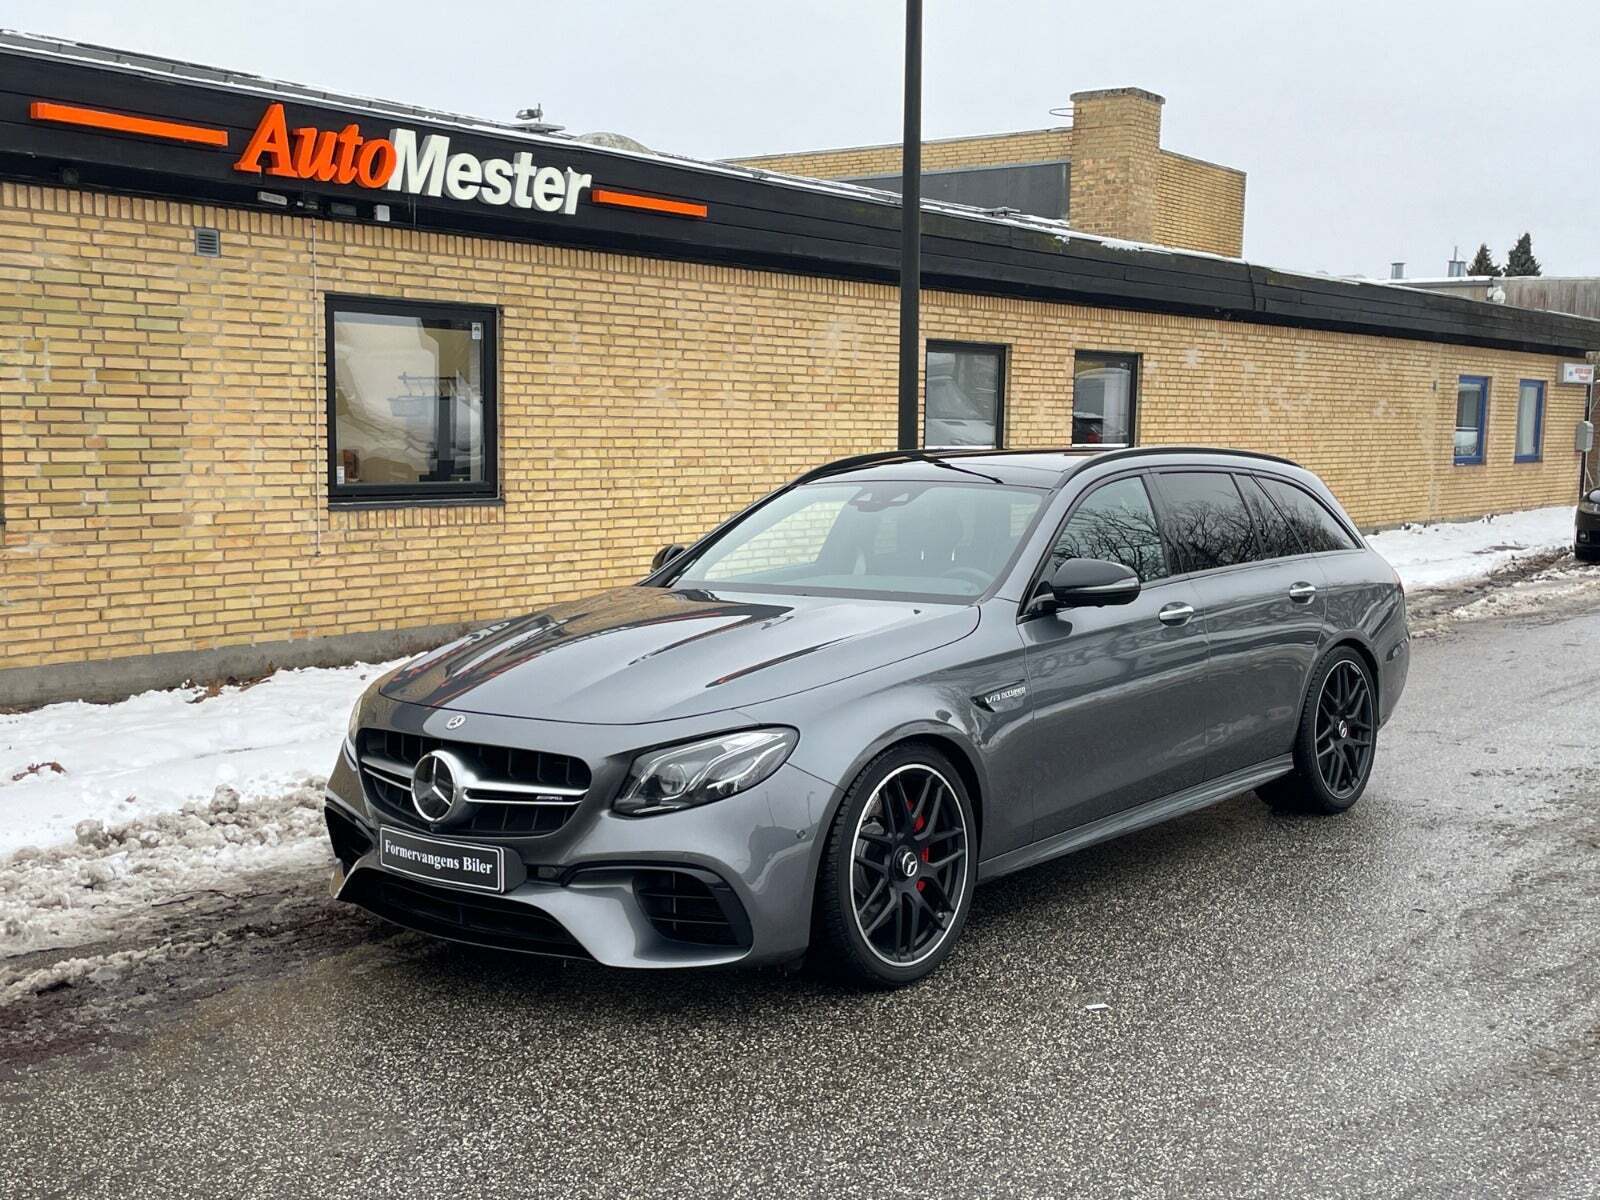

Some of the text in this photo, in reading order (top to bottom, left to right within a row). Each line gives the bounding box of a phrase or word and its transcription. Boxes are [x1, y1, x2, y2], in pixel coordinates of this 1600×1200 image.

[233, 103, 592, 215] AutoMester
[385, 839, 493, 874] Formervangens Biler
